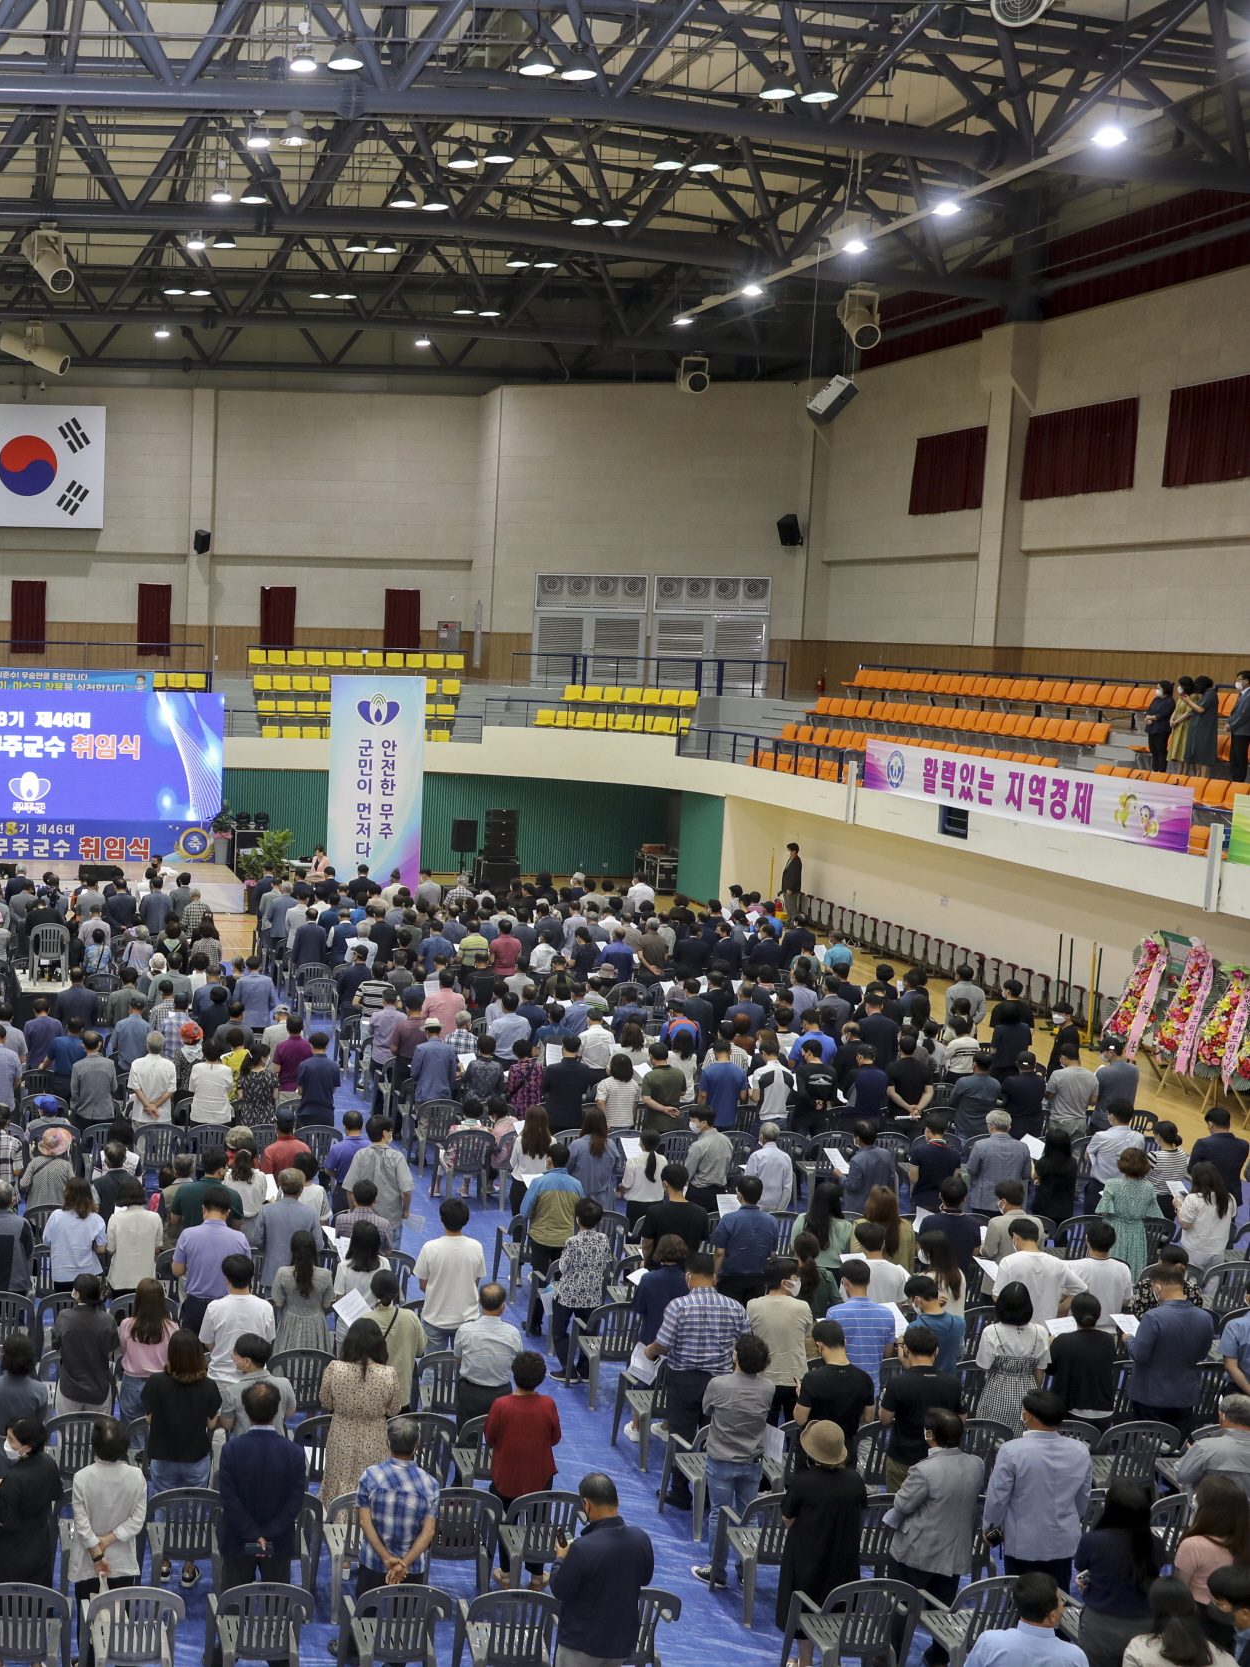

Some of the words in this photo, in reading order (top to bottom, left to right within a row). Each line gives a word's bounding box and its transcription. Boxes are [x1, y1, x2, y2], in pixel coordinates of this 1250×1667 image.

[52, 672, 88, 681] 중요합니다
[34, 711, 91, 729] 제46대
[71, 733, 141, 760] 취임식
[356, 739, 374, 795] 군민이
[380, 739, 397, 797] 안전한
[922, 757, 995, 806] 활력있는
[1004, 771, 1094, 825] 지역경제
[12, 802, 46, 814] 무주군
[36, 823, 75, 836] 제46대
[355, 802, 372, 865] 먼저다.
[378, 803, 394, 840] 무주
[78, 836, 150, 861] 취임식
[188, 835, 202, 851] 축
